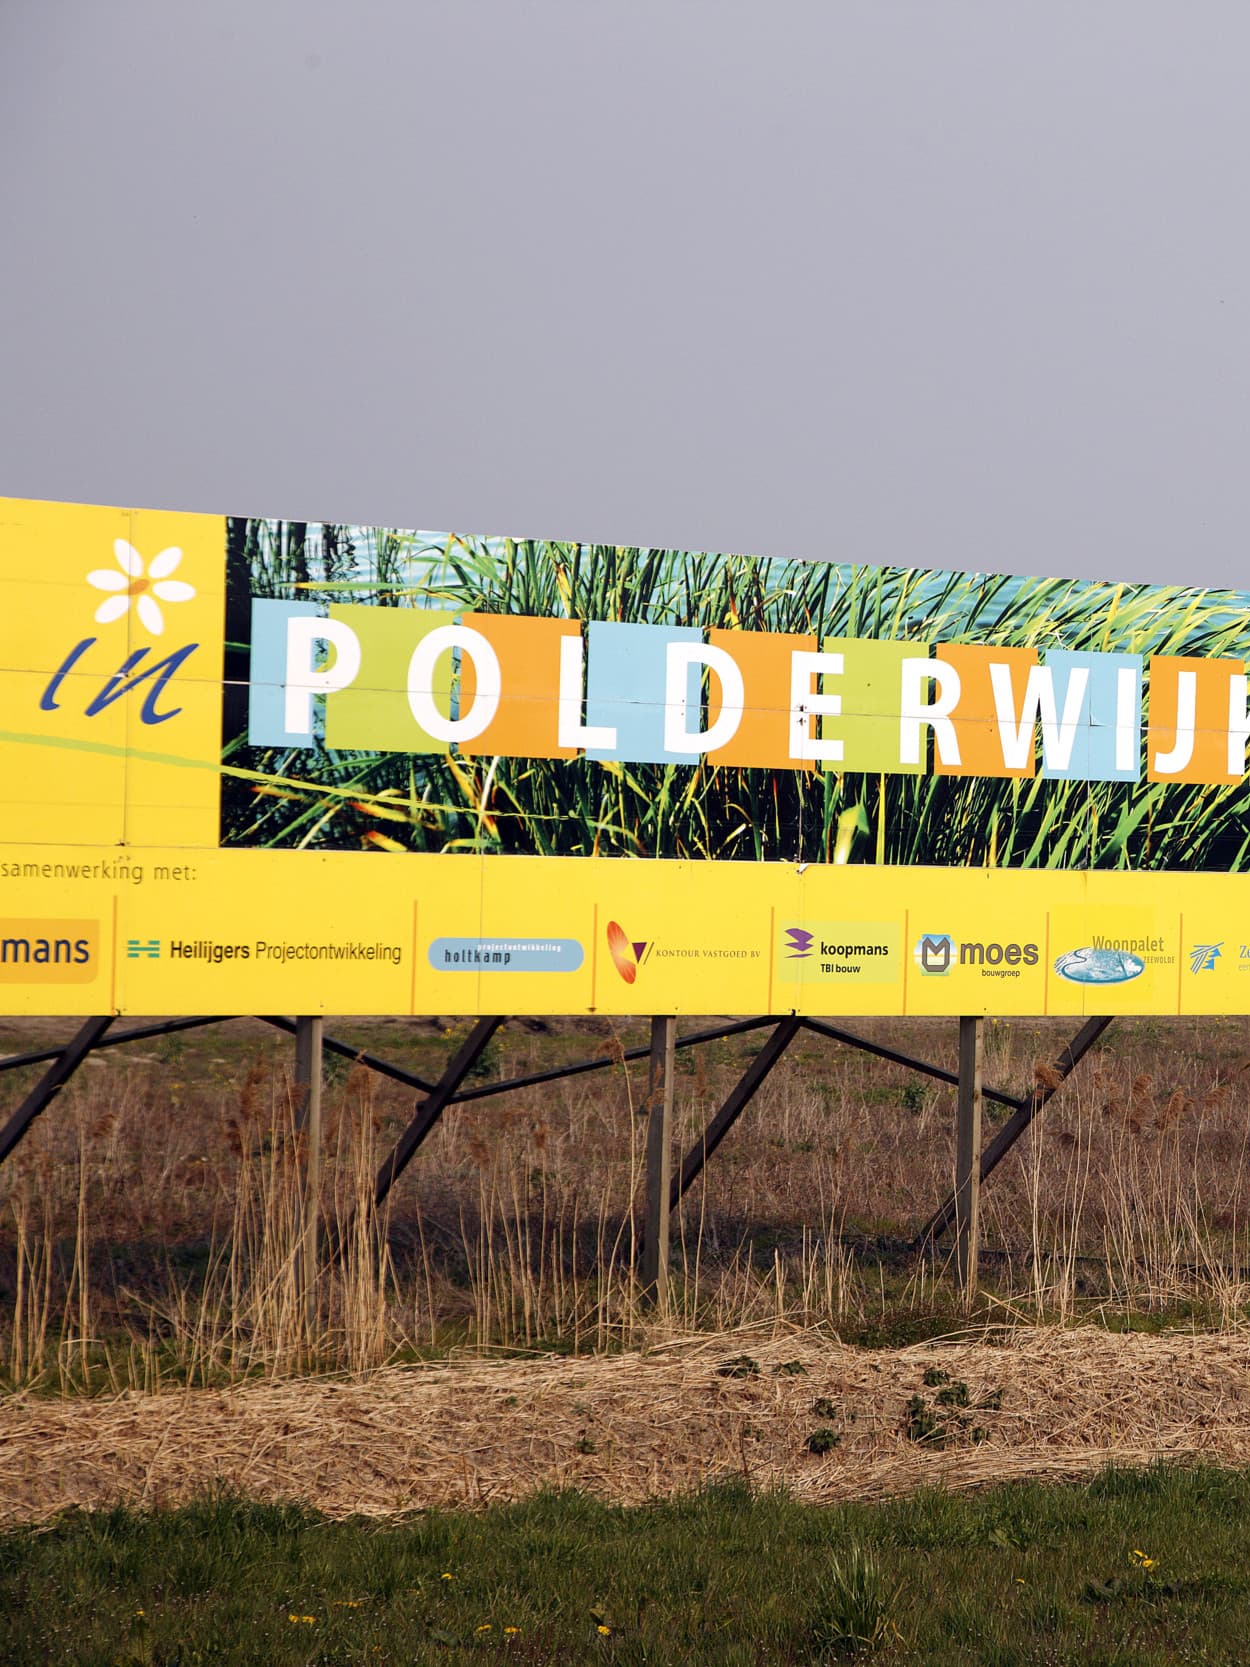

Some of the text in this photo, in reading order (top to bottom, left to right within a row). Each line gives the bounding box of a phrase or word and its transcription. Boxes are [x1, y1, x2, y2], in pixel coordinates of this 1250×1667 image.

[39, 637, 199, 725] in
[0, 860, 197, 885] samenwerking met:
[1, 937, 90, 964] mans
[169, 940, 401, 965] Heilijgers Projectontwikkeling
[820, 942, 889, 959] koopmans
[1092, 935, 1165, 953] Woonpalet
[444, 949, 511, 965] holtkamp
[656, 949, 761, 959] KONTOUR VASTGOED BV
[959, 942, 1039, 965] moes
[1144, 956, 1176, 964] ZEEWOLDE
[821, 963, 861, 974] TBI bouw
[981, 968, 1021, 978] bouwgroep
